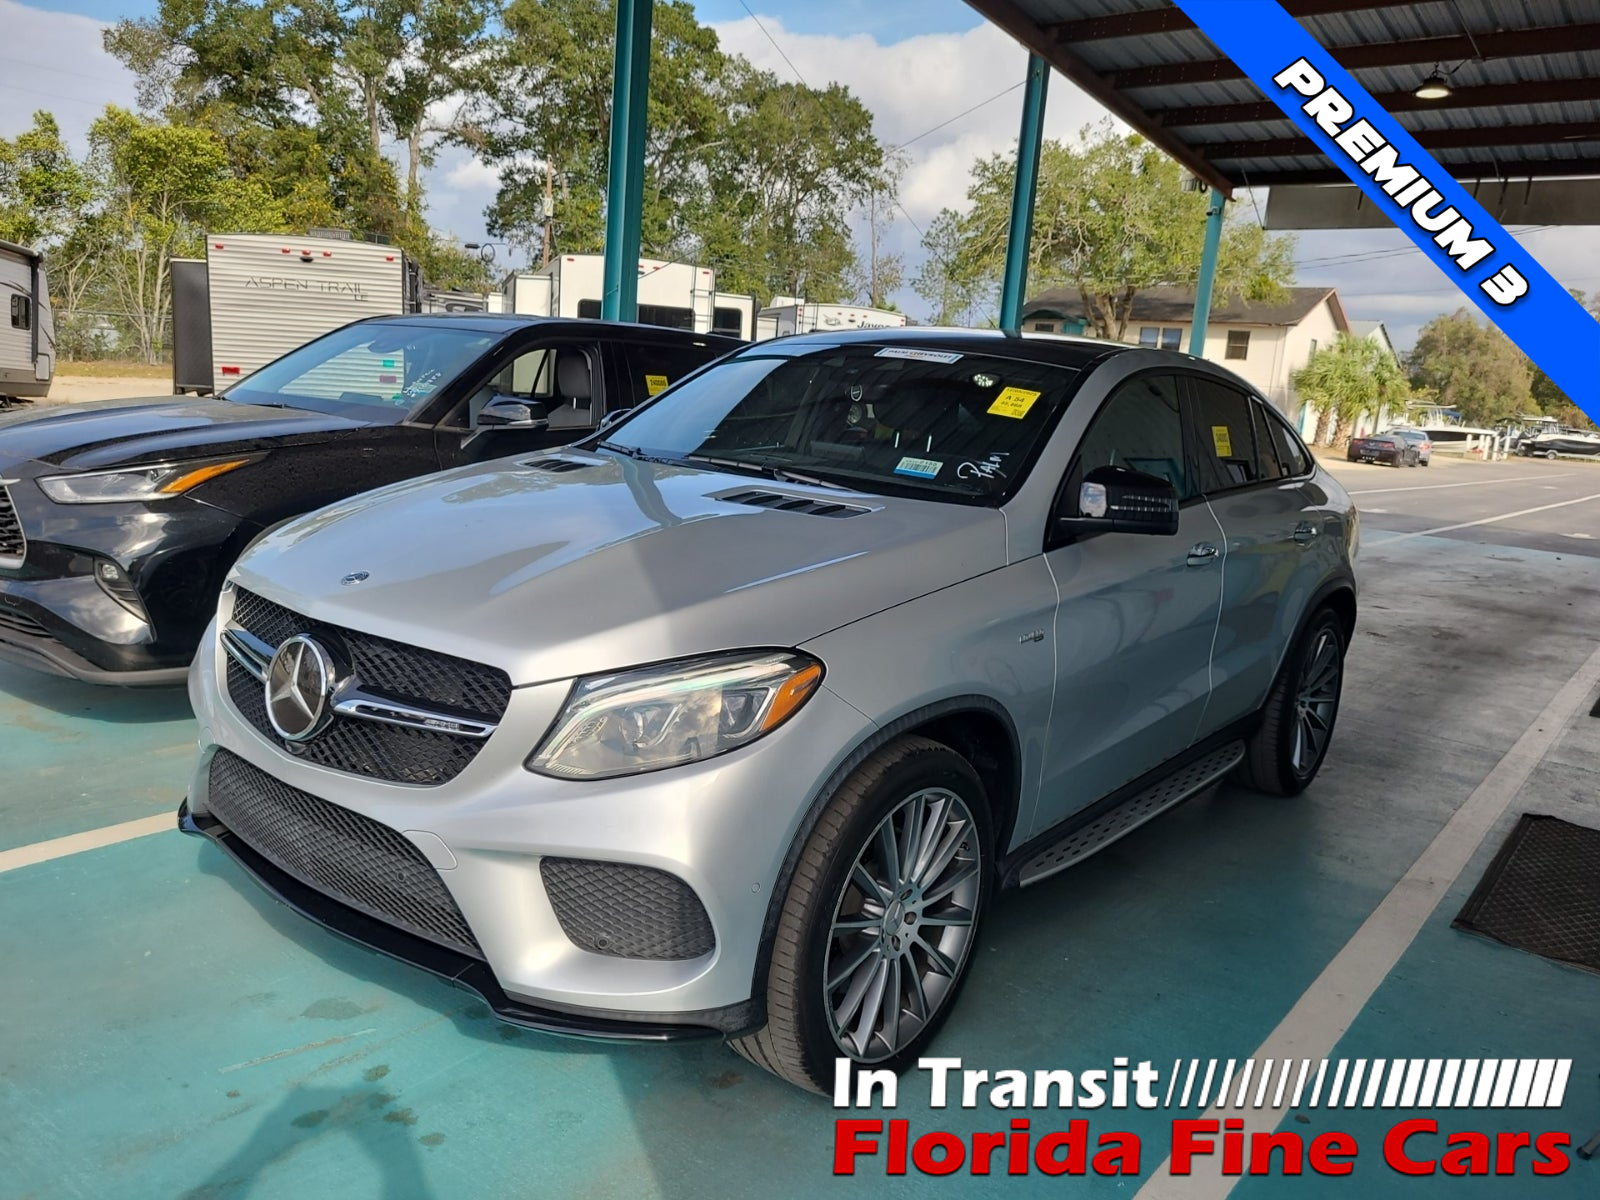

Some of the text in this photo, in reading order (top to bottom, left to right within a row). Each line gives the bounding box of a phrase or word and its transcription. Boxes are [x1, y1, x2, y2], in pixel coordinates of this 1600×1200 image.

[245, 276, 361, 293] ASPEN TRAIL
[354, 294, 369, 302] LE
